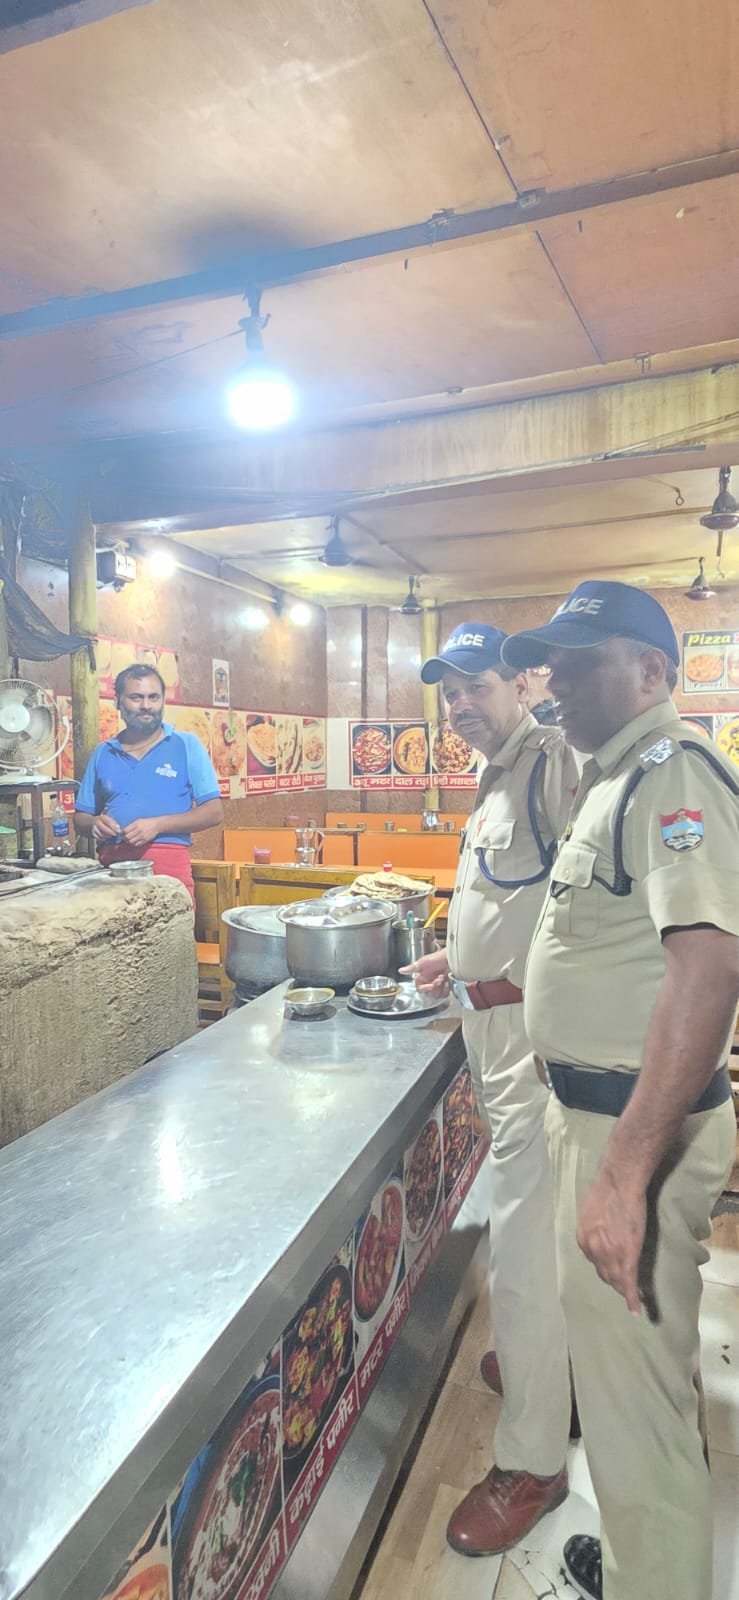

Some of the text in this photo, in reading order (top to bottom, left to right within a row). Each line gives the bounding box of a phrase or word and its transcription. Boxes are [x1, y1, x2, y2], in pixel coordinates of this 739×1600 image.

[687, 633, 731, 647] Pizza
[395, 777, 414, 786] दाल
[359, 1290, 408, 1388] मटर पनीर
[325, 1388, 355, 1448] पनीर
